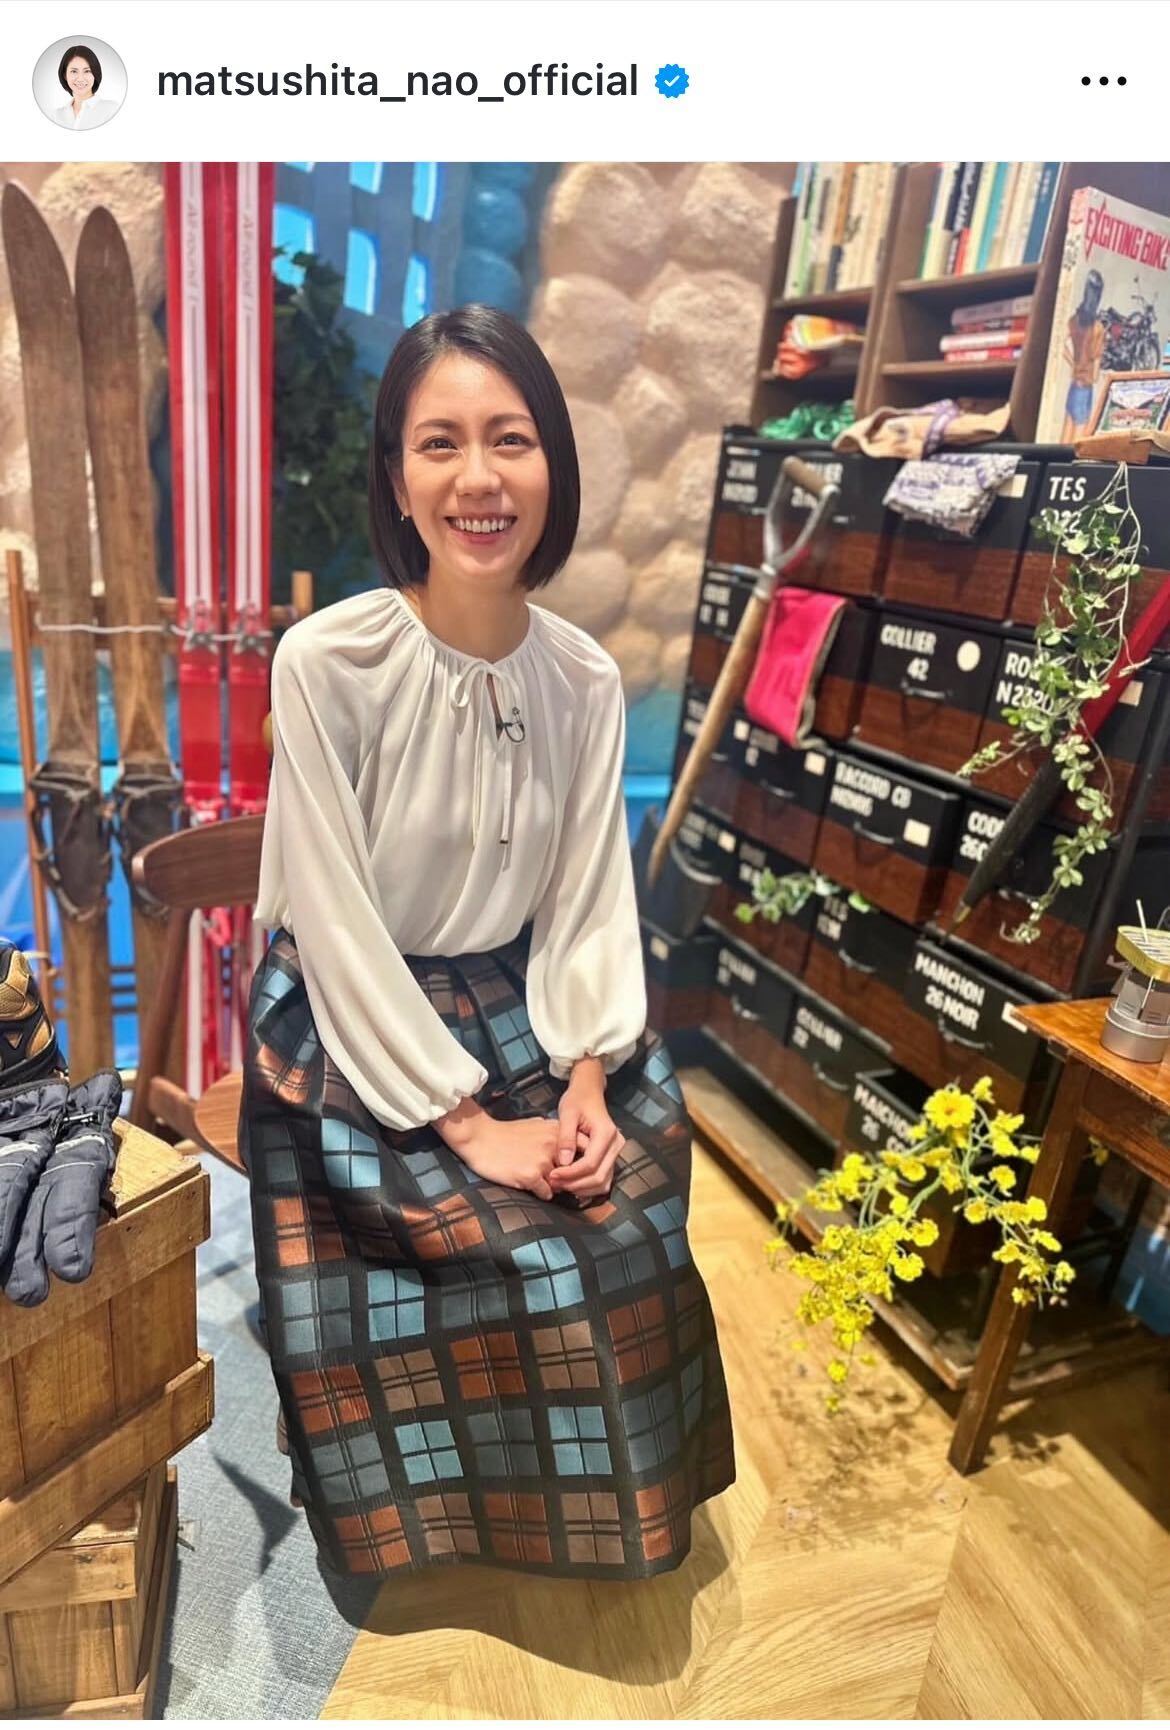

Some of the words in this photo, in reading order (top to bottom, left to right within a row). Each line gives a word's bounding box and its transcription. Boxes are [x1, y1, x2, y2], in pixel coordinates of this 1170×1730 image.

[1084, 197, 1143, 263] EXCITING
[1049, 476, 1088, 502] TES
[914, 952, 985, 1007] MANCHON
[942, 995, 980, 1031] NOIR
